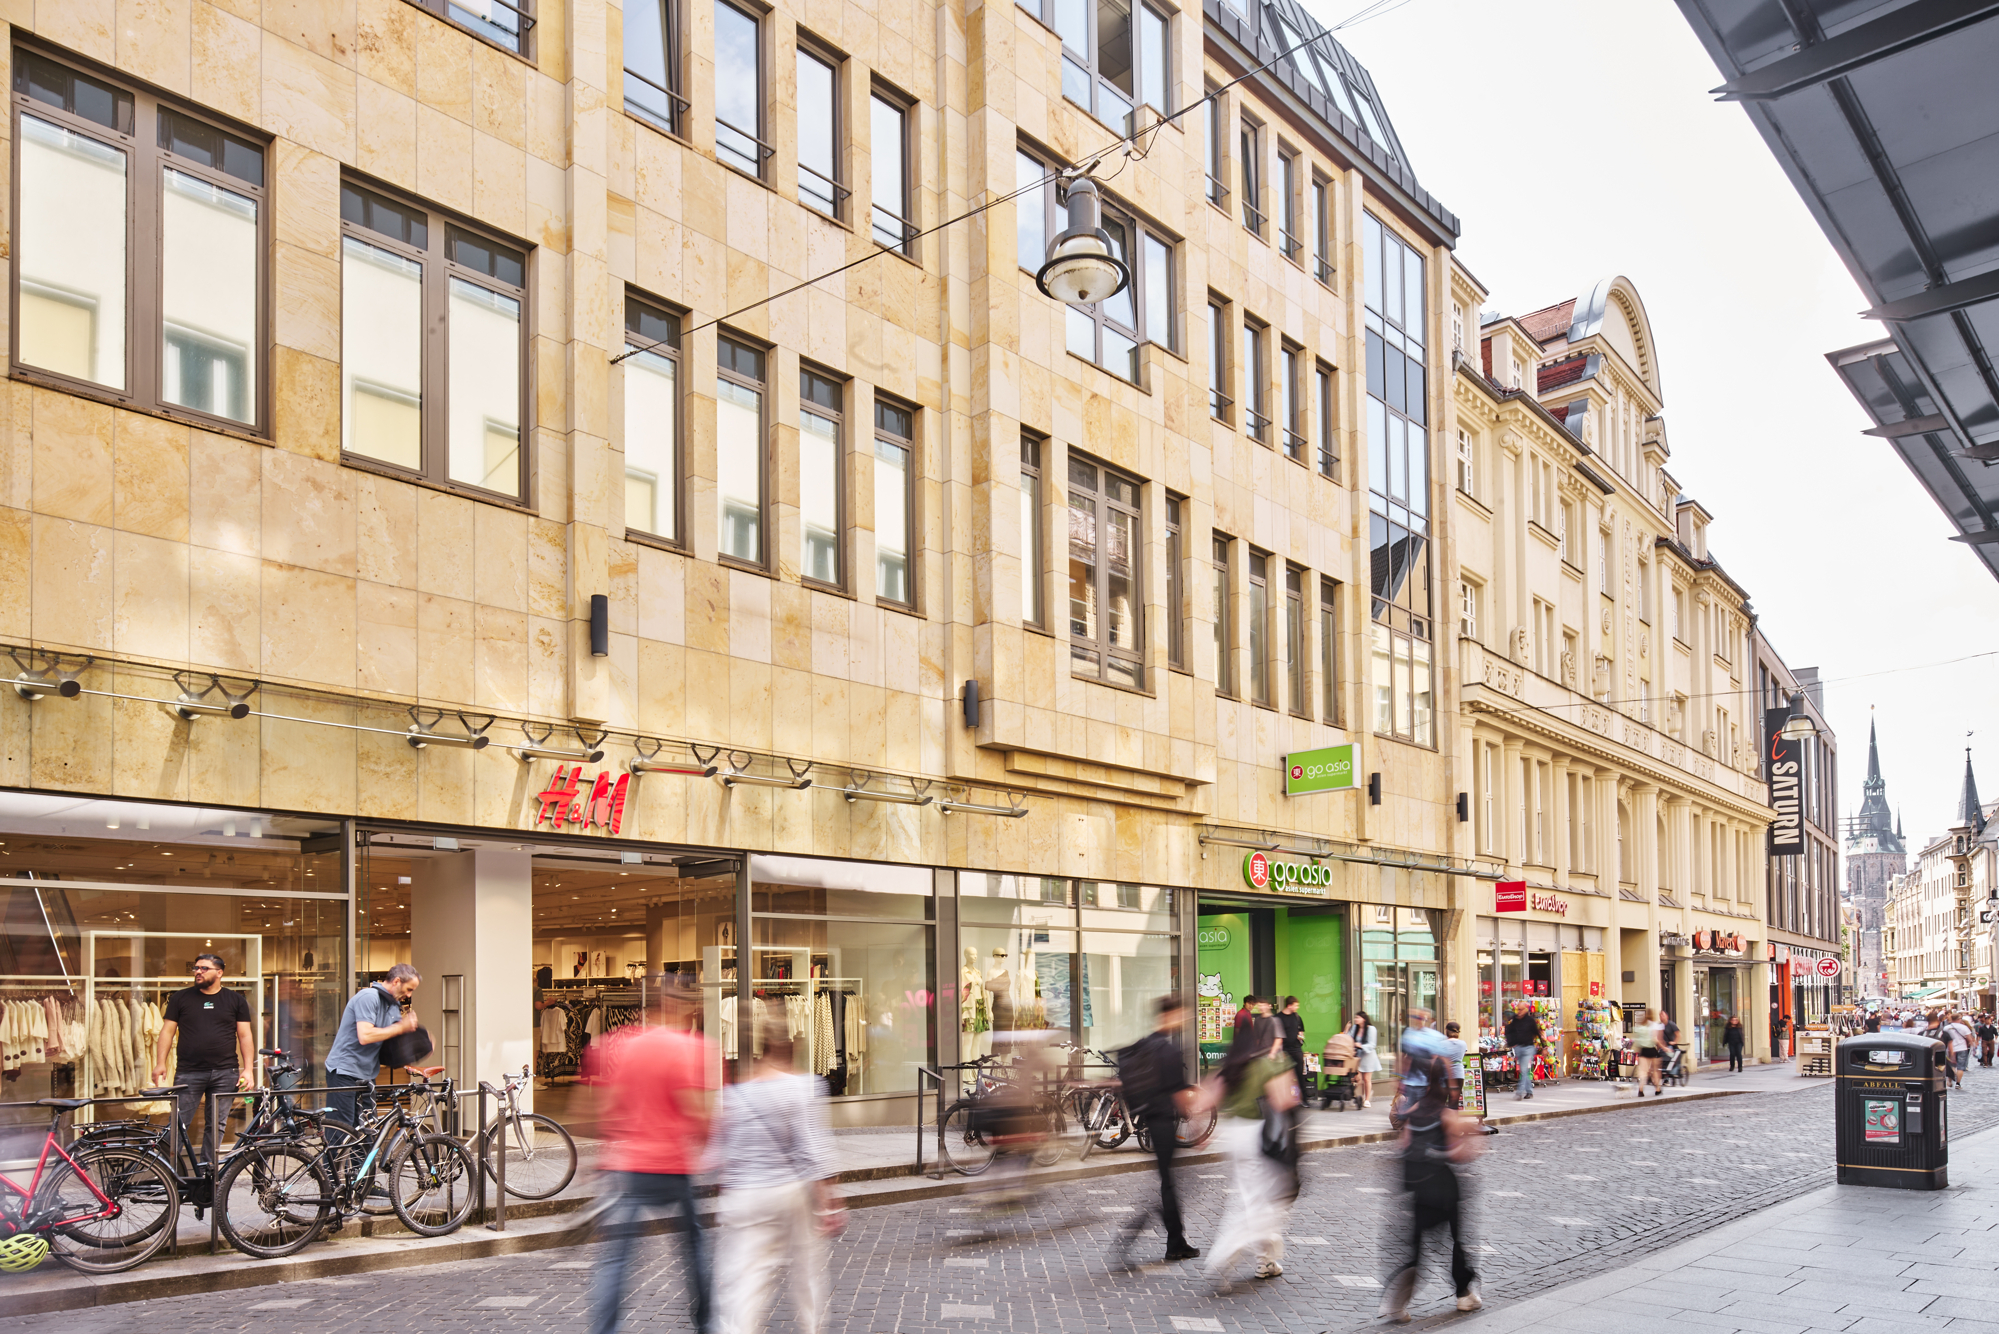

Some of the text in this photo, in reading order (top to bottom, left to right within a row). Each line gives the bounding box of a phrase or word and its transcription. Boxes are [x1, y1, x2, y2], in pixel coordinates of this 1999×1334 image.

[1307, 760, 1350, 779] go asia
[536, 765, 630, 834] H&M
[1772, 761, 1800, 845] SATURN
[1253, 860, 1266, 880] 東
[1272, 860, 1333, 891] go asia
[1285, 885, 1326, 895] asien supermarkt
[1533, 893, 1568, 917] EuroShop
[1199, 928, 1228, 943] asia
